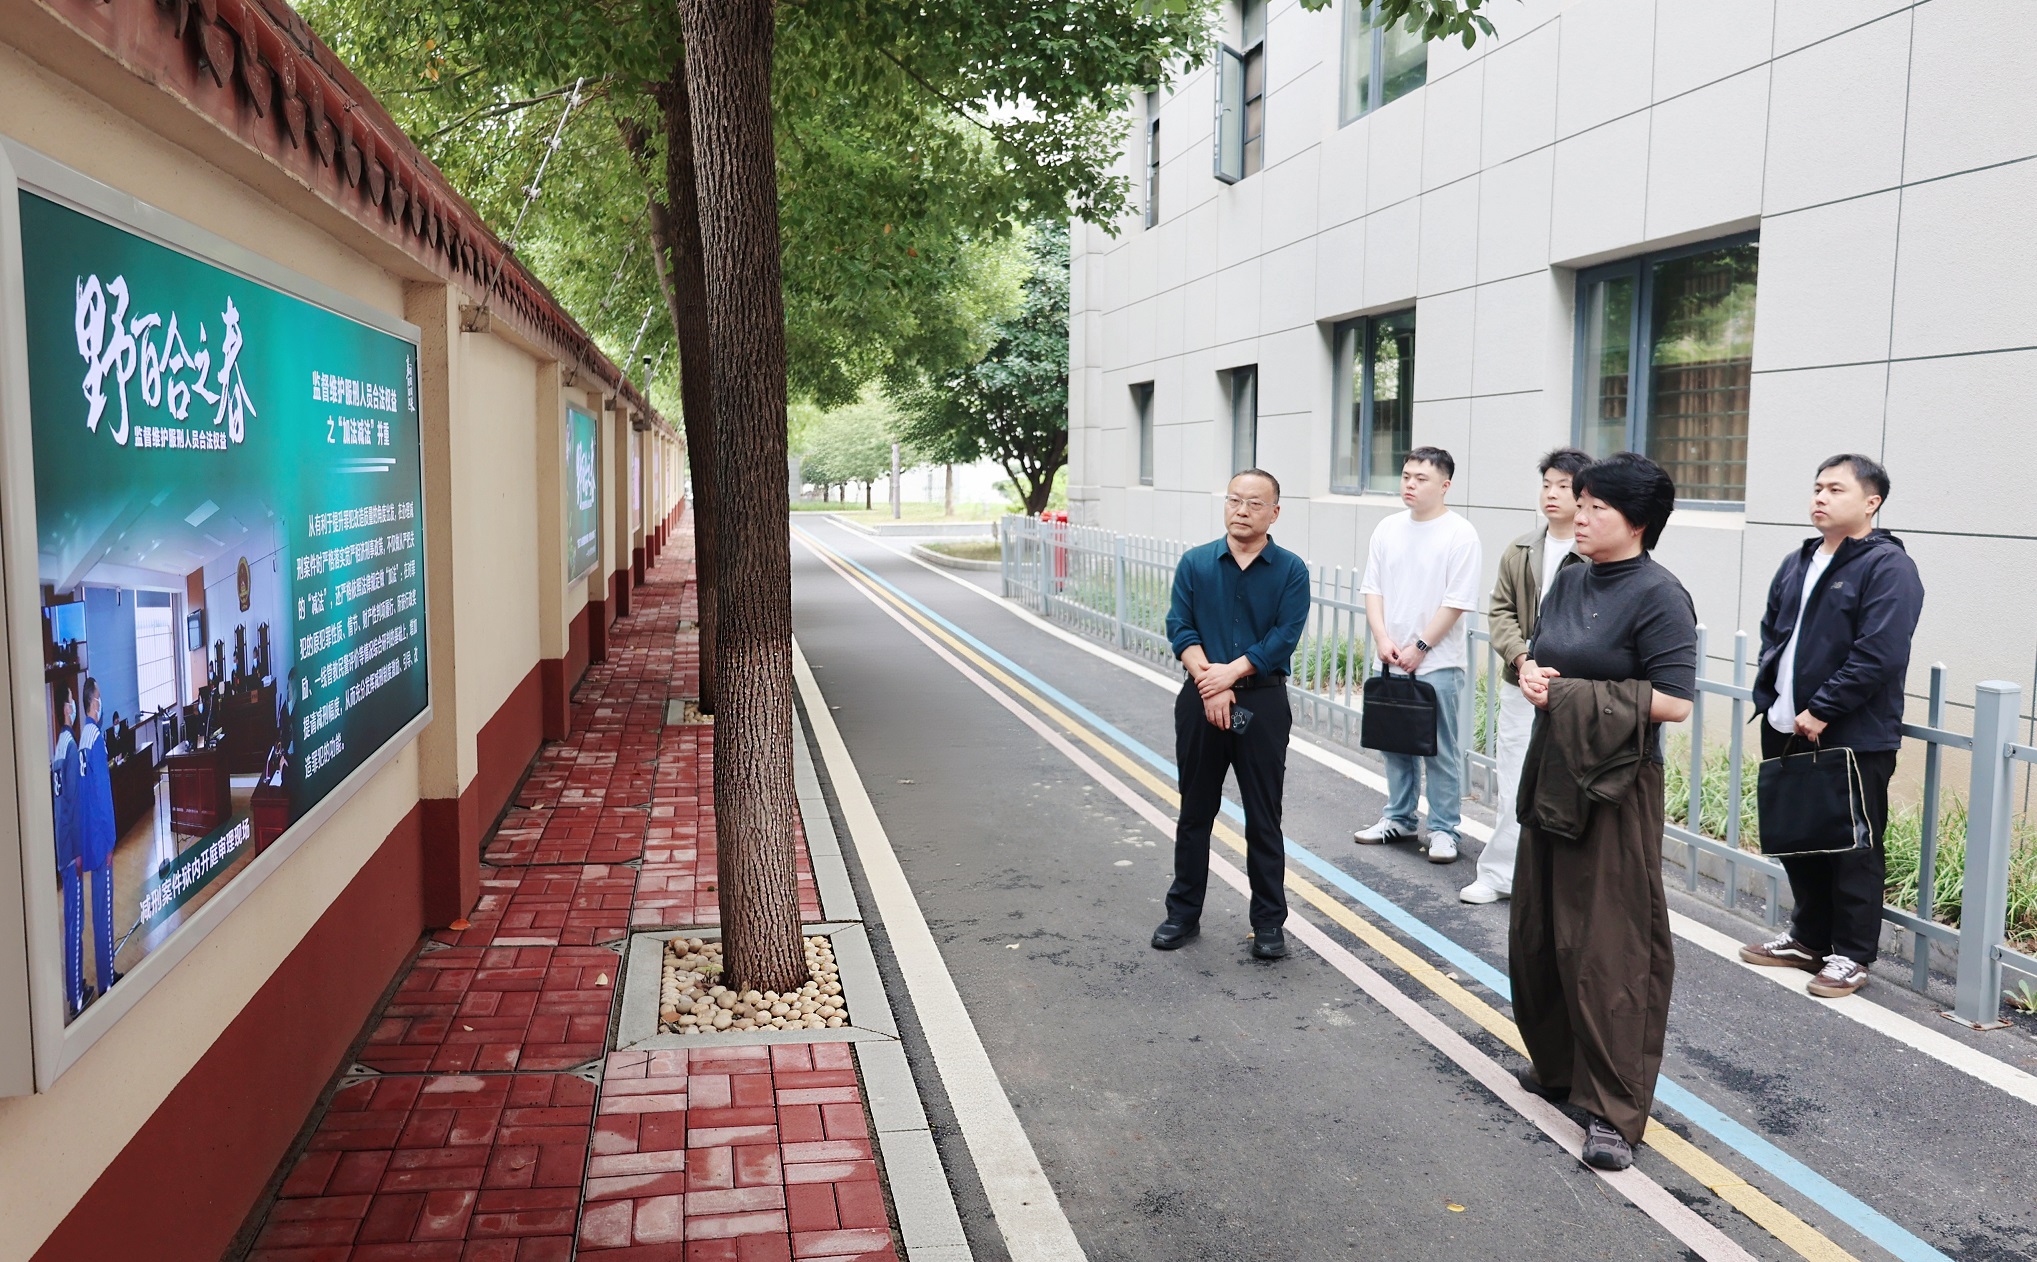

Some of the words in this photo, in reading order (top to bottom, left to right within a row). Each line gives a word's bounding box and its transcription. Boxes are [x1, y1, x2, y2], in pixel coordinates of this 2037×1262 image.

[75, 273, 257, 446] 野百合之春
[312, 370, 398, 413] 监督维护服刑人员合法权益
[134, 425, 228, 450] 监督维护服刑人员合法权益
[139, 817, 251, 925] 减刑案件狱内开庭审理现场
